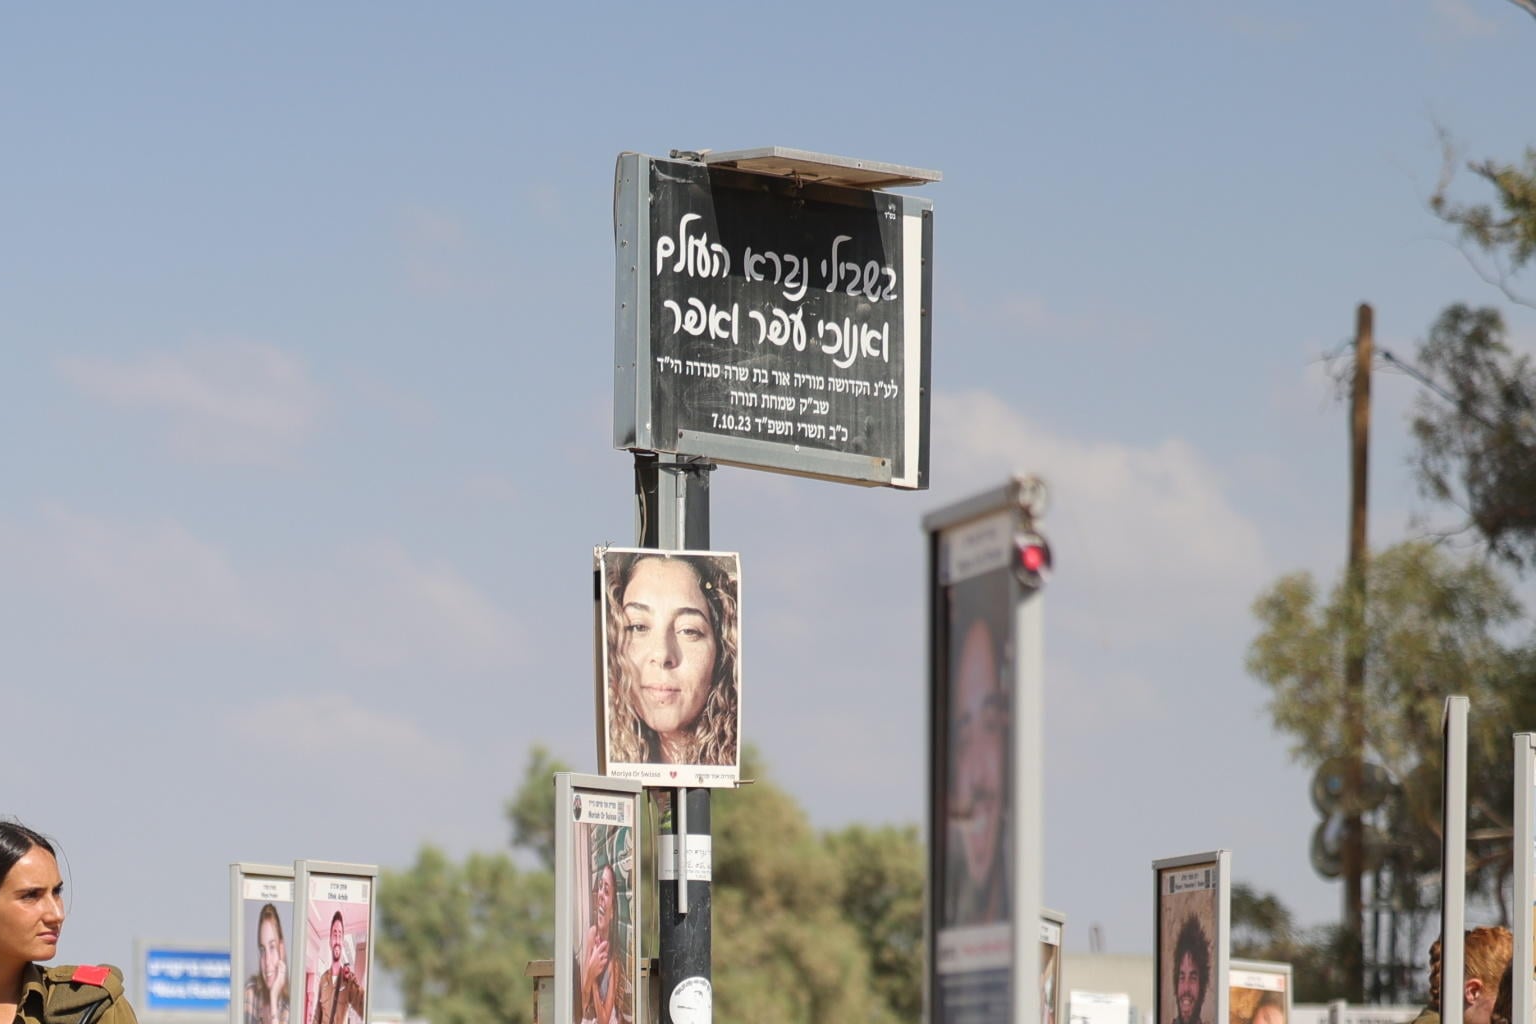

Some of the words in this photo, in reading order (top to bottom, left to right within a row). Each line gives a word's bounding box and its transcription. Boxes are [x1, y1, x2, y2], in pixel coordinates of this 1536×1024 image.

[657, 213, 730, 278] העולם
[744, 246, 809, 301] נברא
[821, 234, 897, 303] בשבילי
[664, 297, 739, 345] ואפר
[749, 305, 807, 352] עפר
[818, 317, 889, 369] ואנוכי
[686, 361, 720, 378] סנדרה
[724, 365, 749, 381] שרה
[753, 368, 768, 383] בת
[771, 370, 790, 386] אור
[794, 373, 824, 390] מוריה
[828, 377, 870, 397] הקדושה
[730, 391, 758, 407] תורה
[761, 393, 796, 411] שמחת
[712, 413, 751, 432] 7.10.23
[797, 422, 826, 439] תשרי
